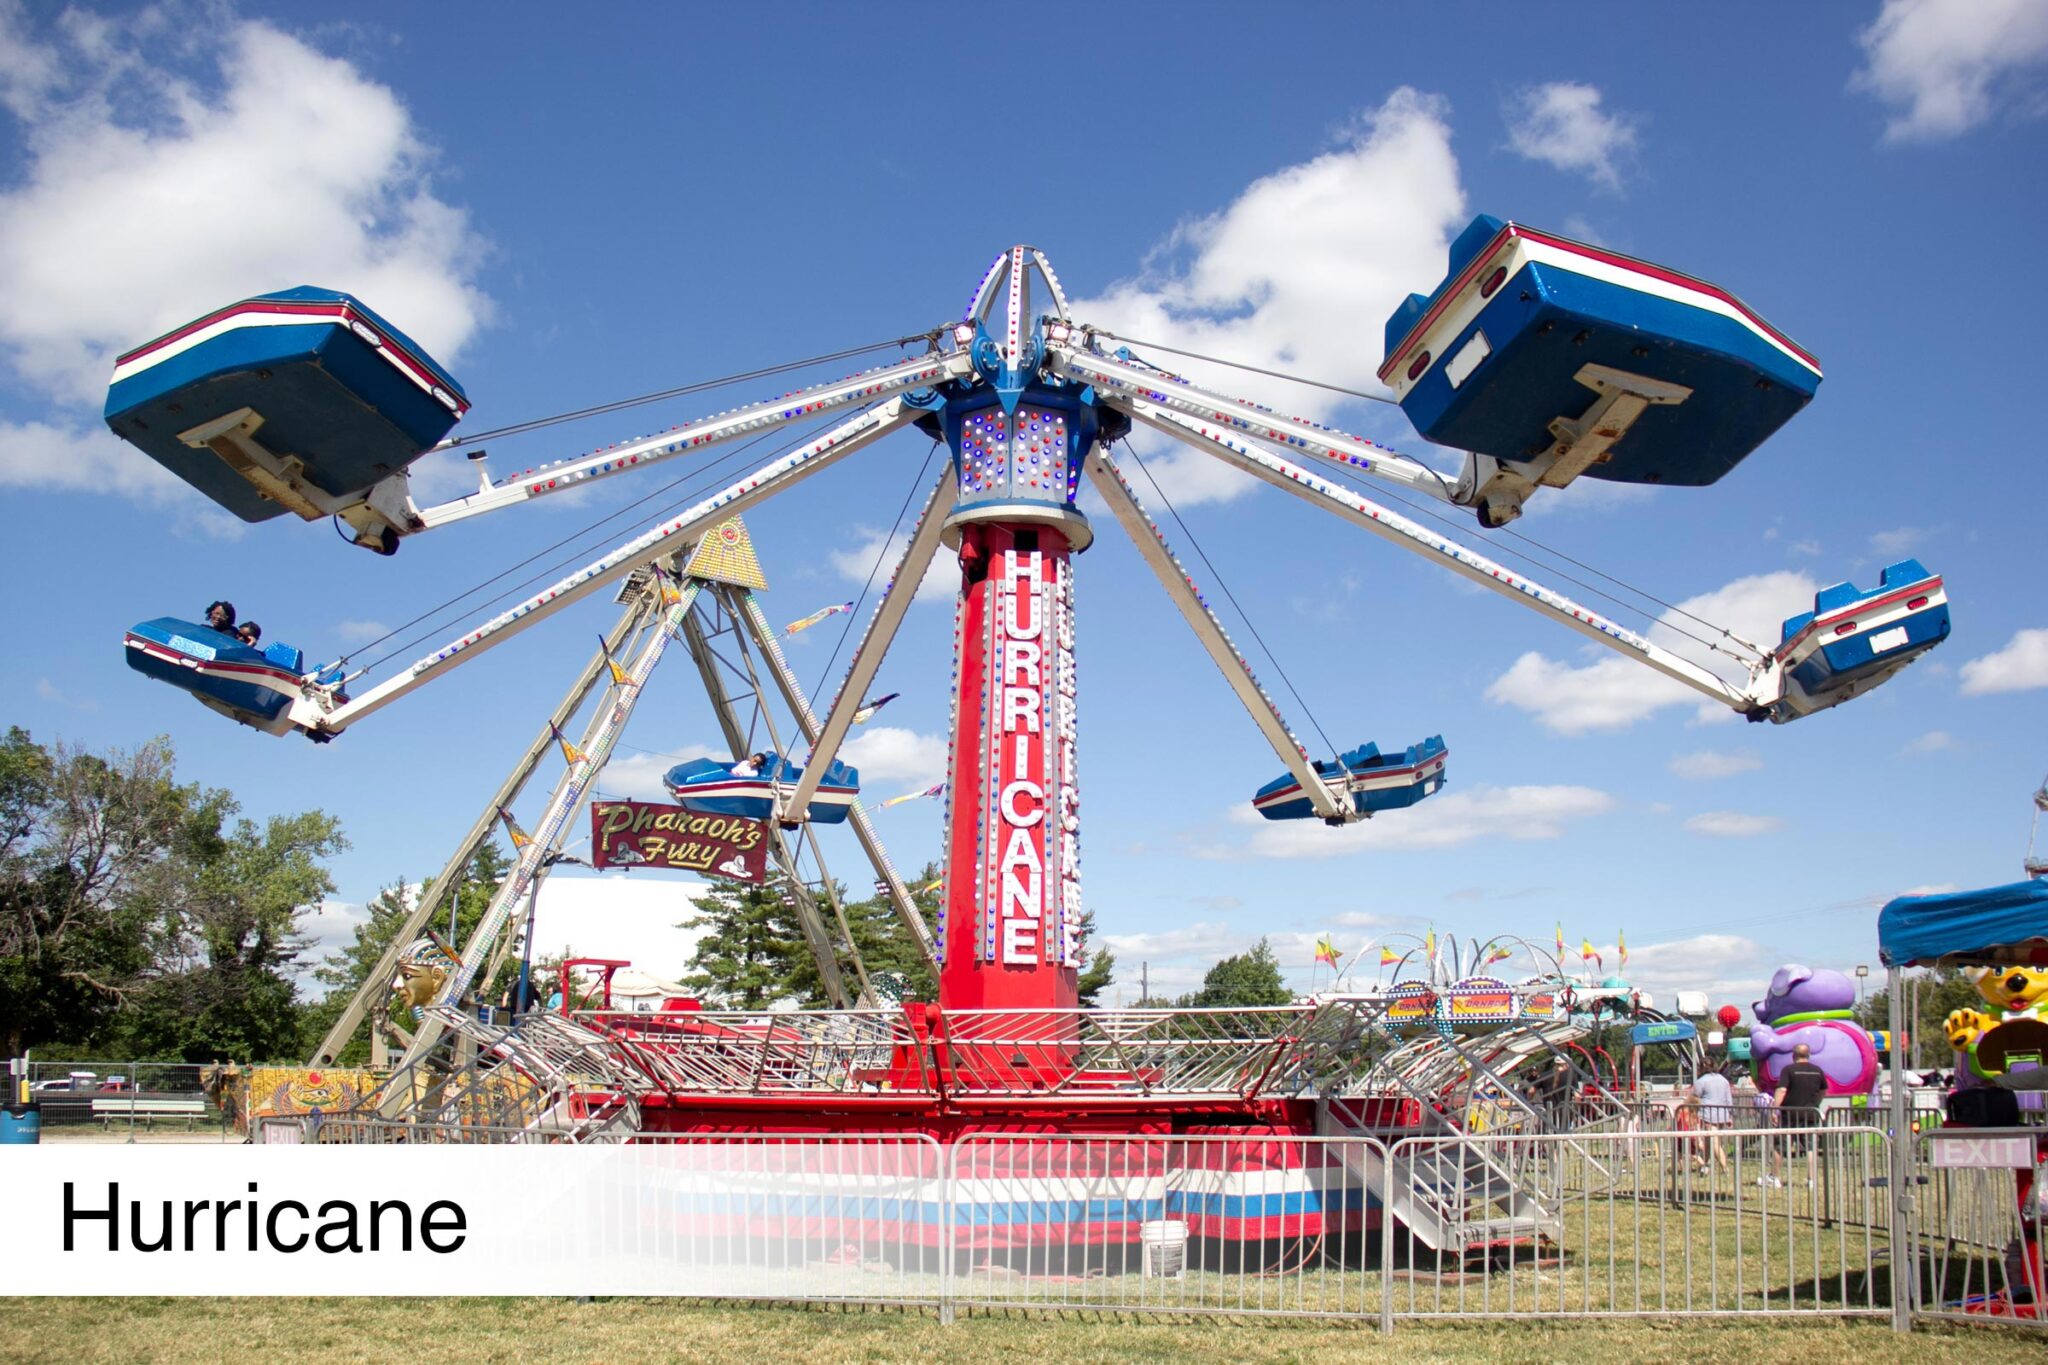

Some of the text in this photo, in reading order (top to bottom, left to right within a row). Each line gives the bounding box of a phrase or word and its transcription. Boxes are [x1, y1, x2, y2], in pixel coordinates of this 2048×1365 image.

[1000, 550, 1045, 965] HURRICANE
[598, 805, 762, 851] Pharaoh's
[638, 836, 721, 870] Fury
[1648, 1024, 1679, 1037] ENTER
[272, 1126, 299, 1144] EXIT
[1944, 1138, 2020, 1164] EXIT
